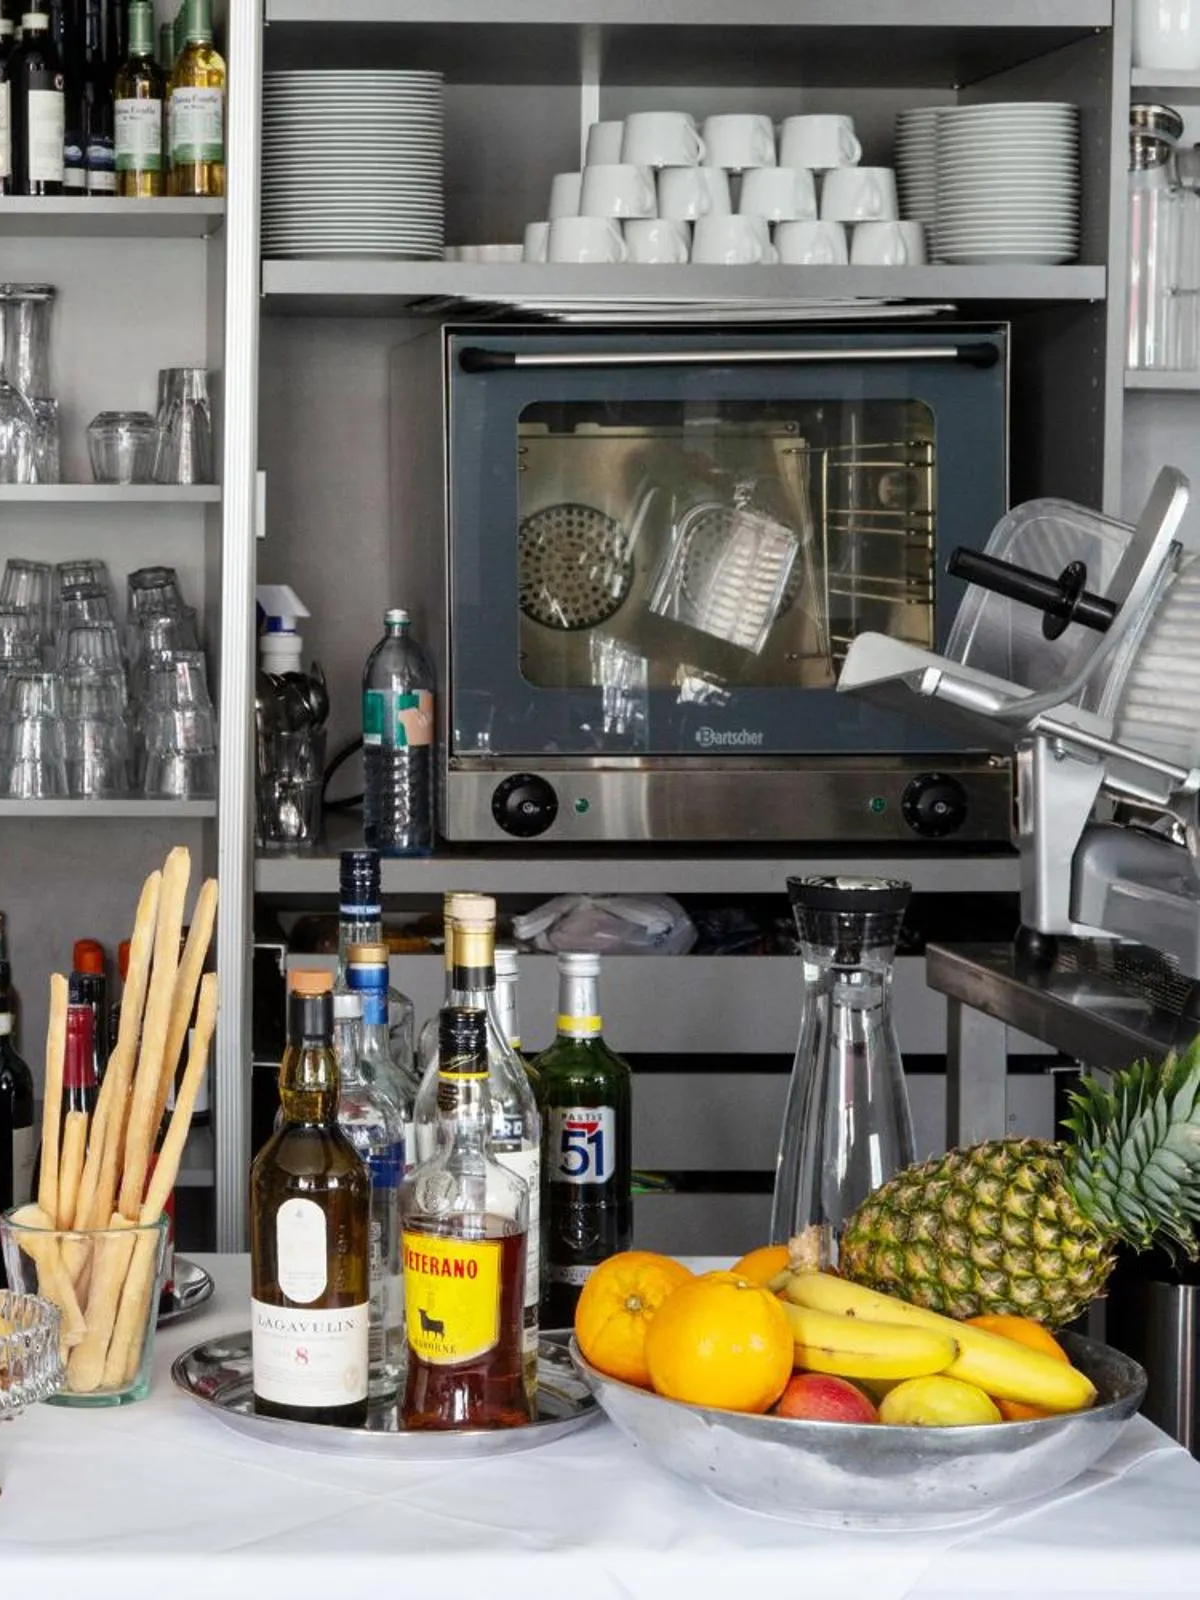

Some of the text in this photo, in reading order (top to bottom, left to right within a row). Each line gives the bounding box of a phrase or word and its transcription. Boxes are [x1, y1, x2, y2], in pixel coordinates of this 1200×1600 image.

[696, 726, 764, 747] Bartscher
[558, 1129, 605, 1177] 51
[257, 1313, 356, 1335] LAGAVULIN
[294, 1346, 310, 1366] 8
